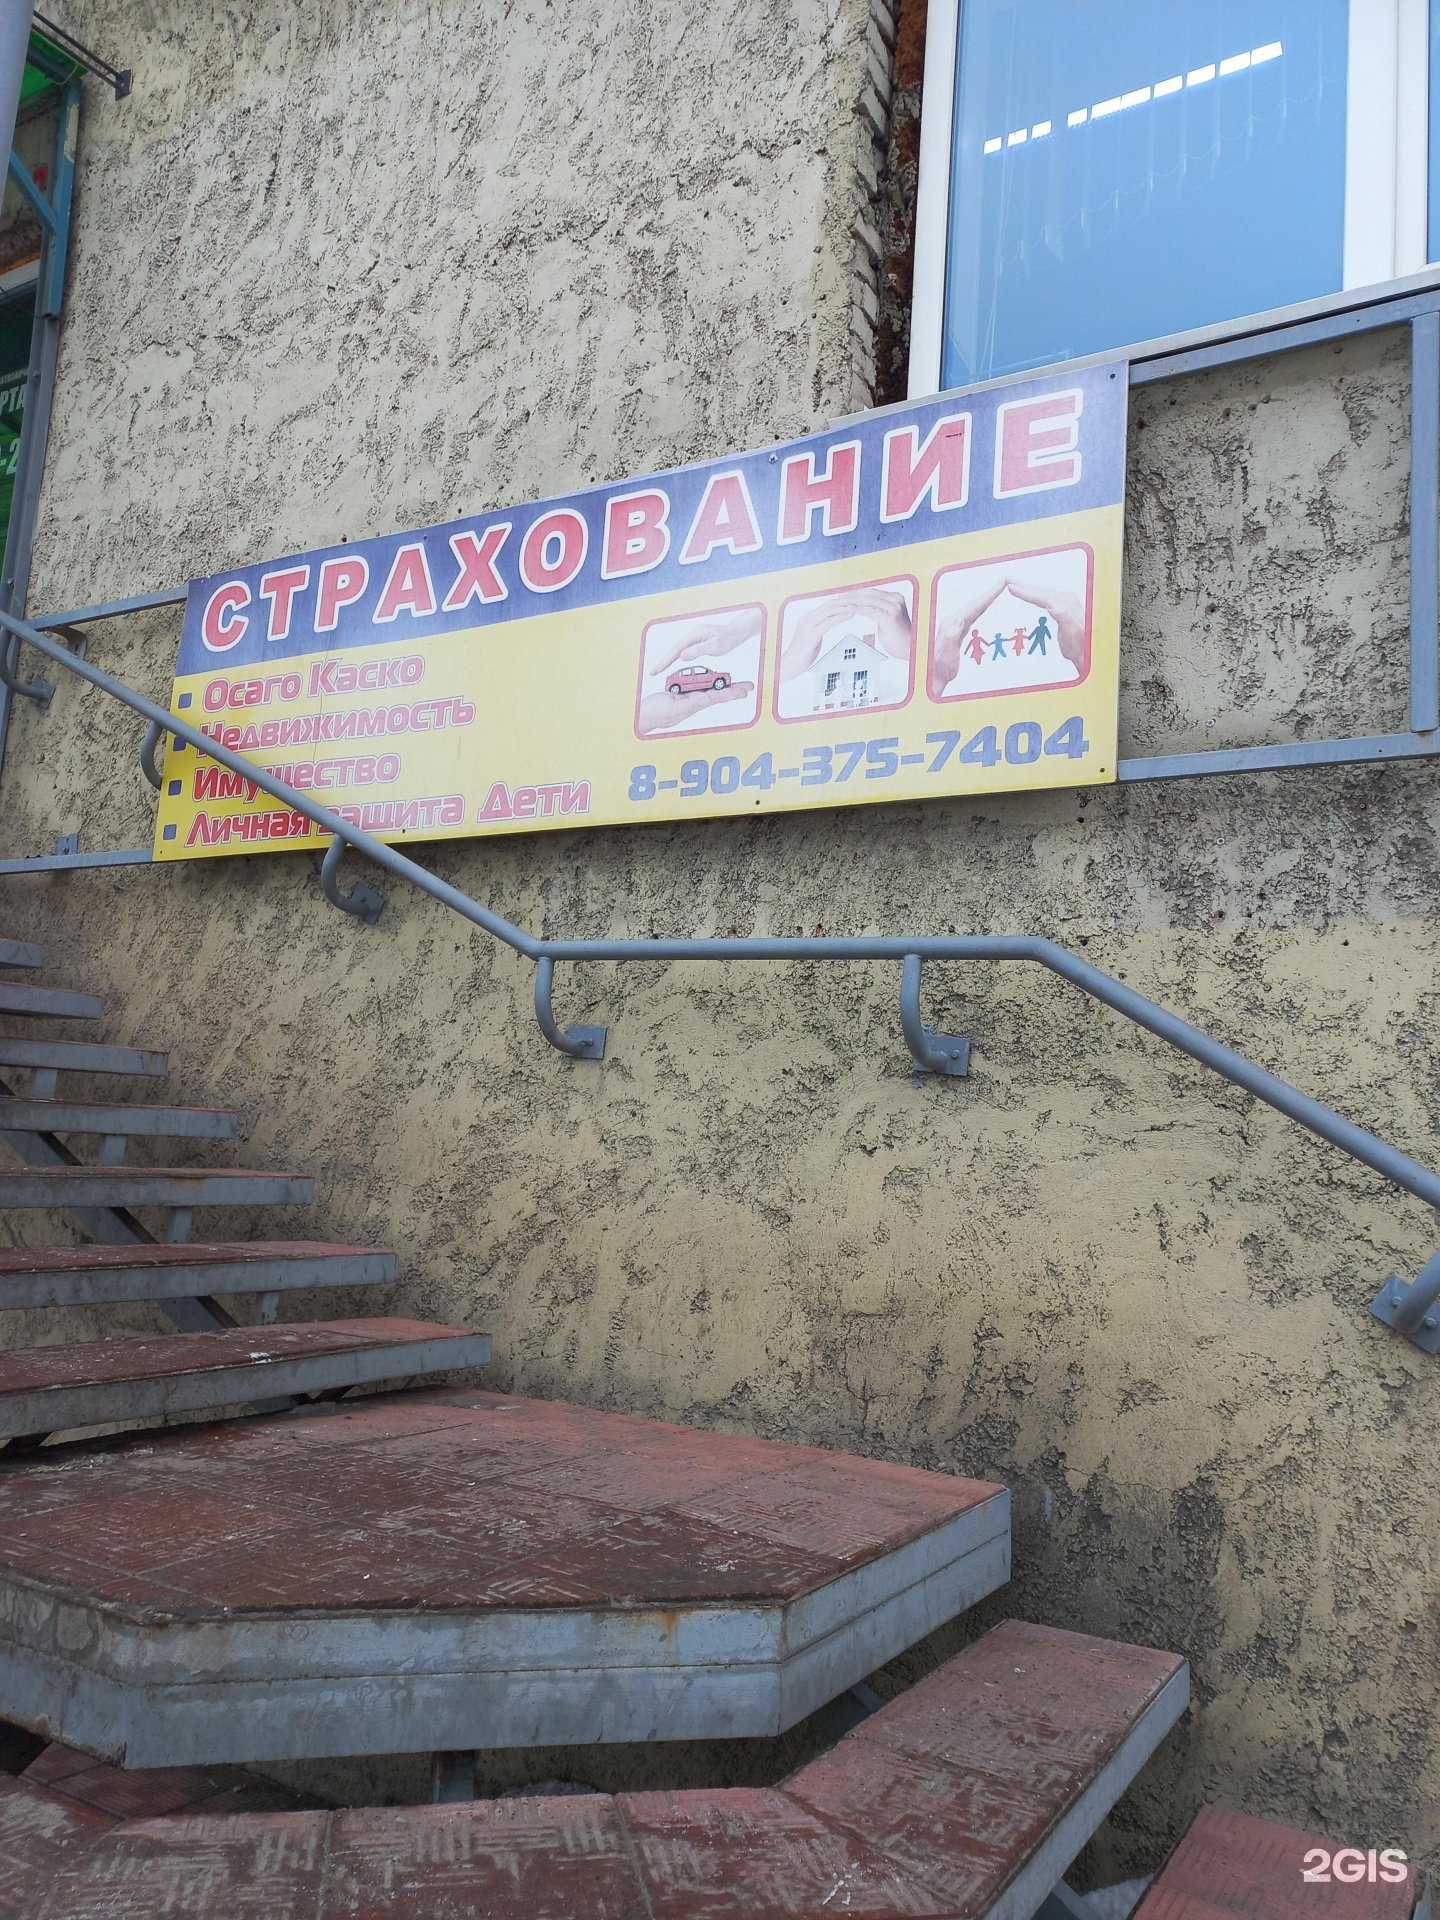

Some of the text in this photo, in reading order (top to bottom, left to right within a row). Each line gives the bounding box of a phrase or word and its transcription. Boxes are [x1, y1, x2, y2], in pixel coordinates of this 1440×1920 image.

[201, 388, 1083, 653] СТРАХОВАНИЕ
[202, 655, 425, 713] Осаго Каско
[628, 716, 1089, 801] 8-904-375-7404
[184, 809, 313, 848] Личная
[477, 780, 592, 822] Дети
